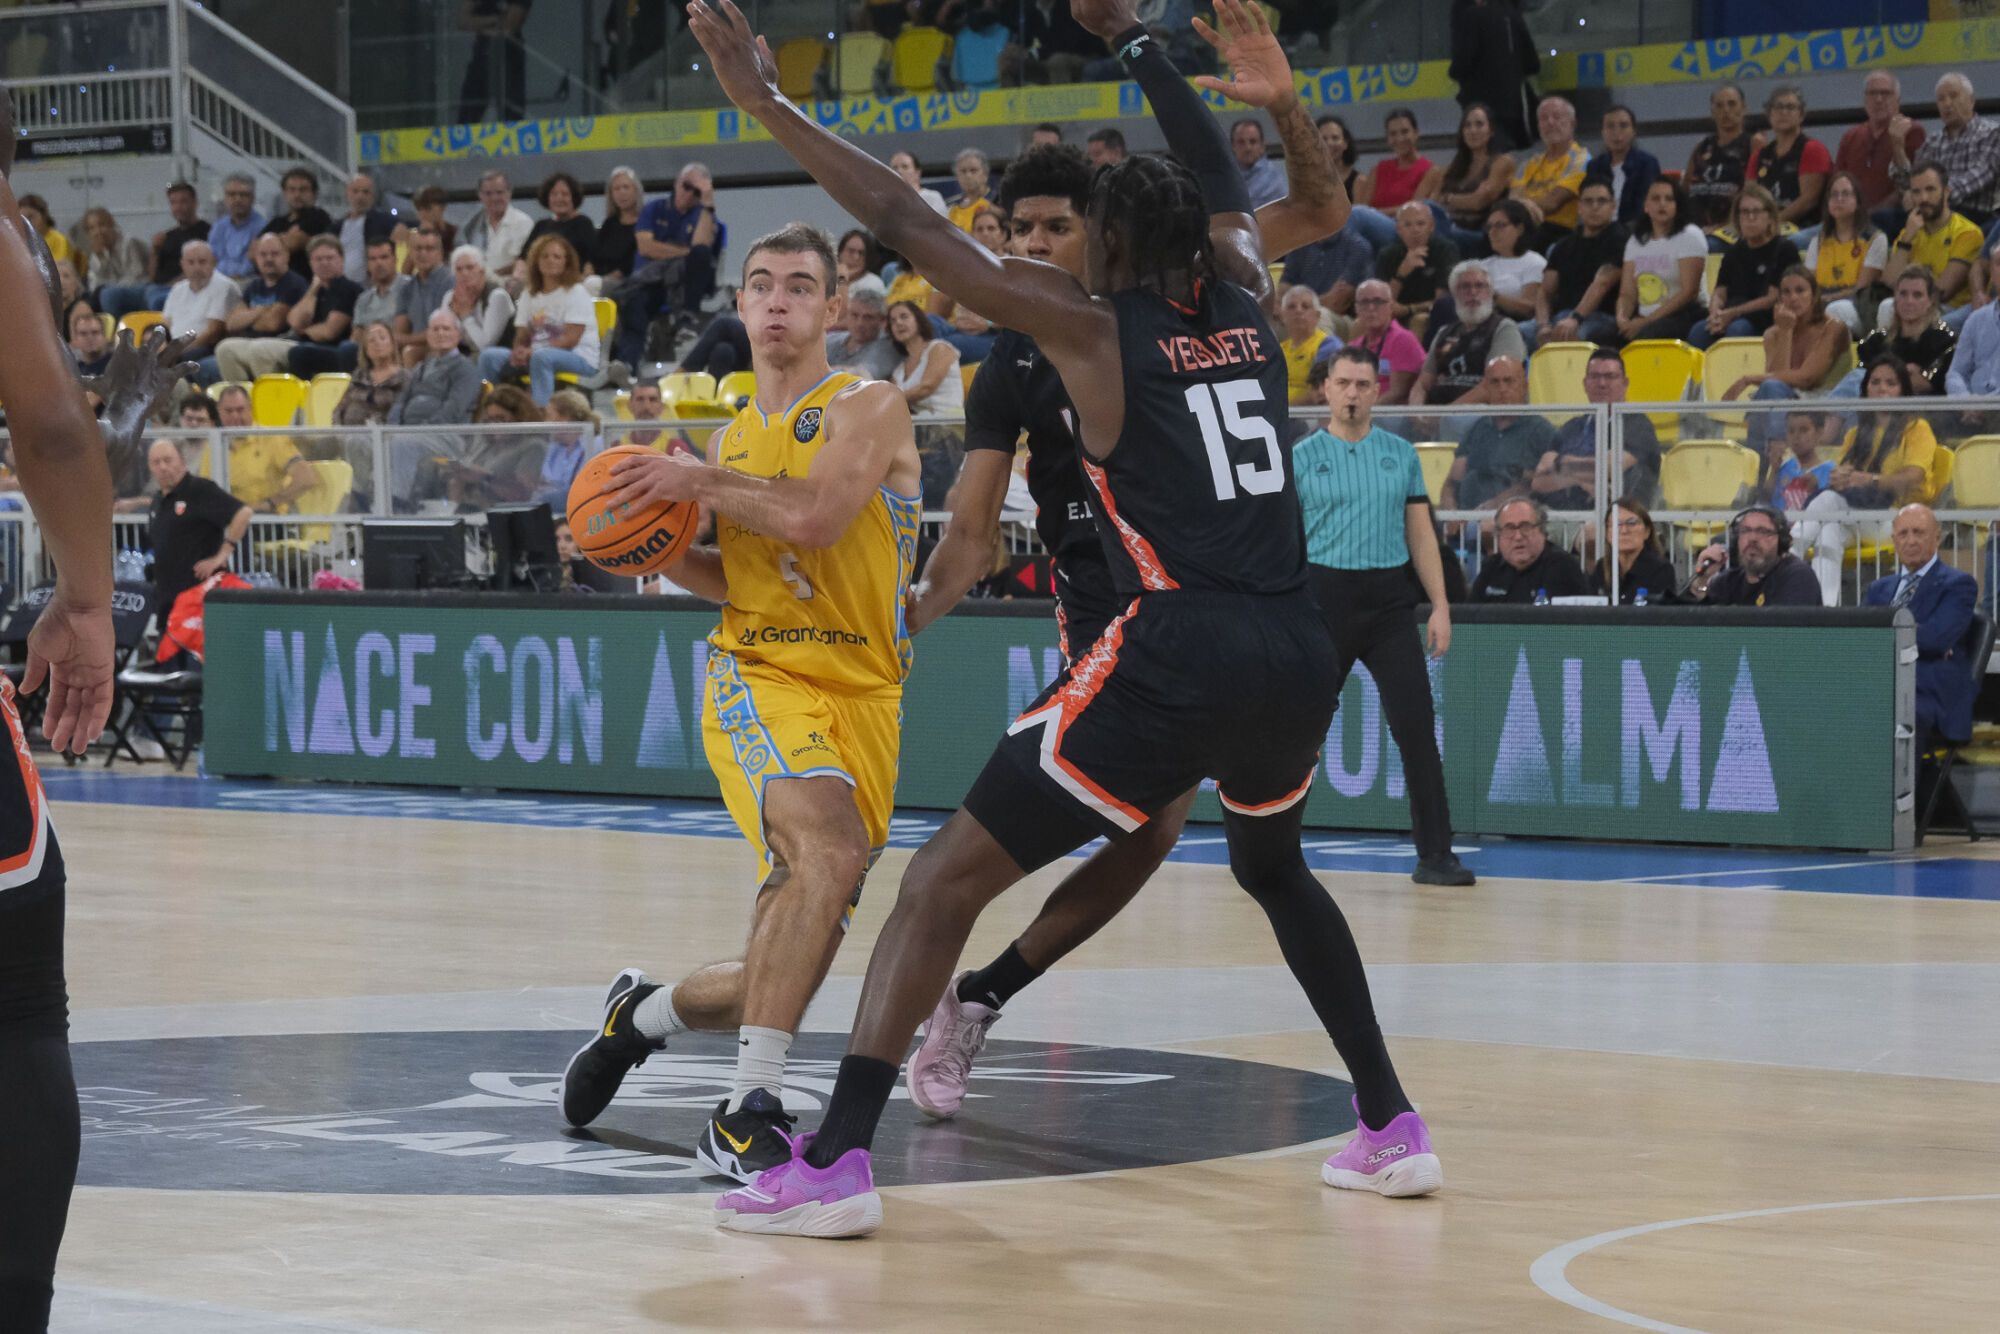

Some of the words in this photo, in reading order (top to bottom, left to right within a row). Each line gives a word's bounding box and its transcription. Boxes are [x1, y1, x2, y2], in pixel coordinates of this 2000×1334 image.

[1157, 328, 1267, 372] YEGUETE
[1184, 379, 1285, 500] 15
[592, 527, 675, 567] Wilson
[264, 620, 437, 760] NACE
[464, 634, 604, 765] CON
[1487, 642, 1780, 813] ALMA
